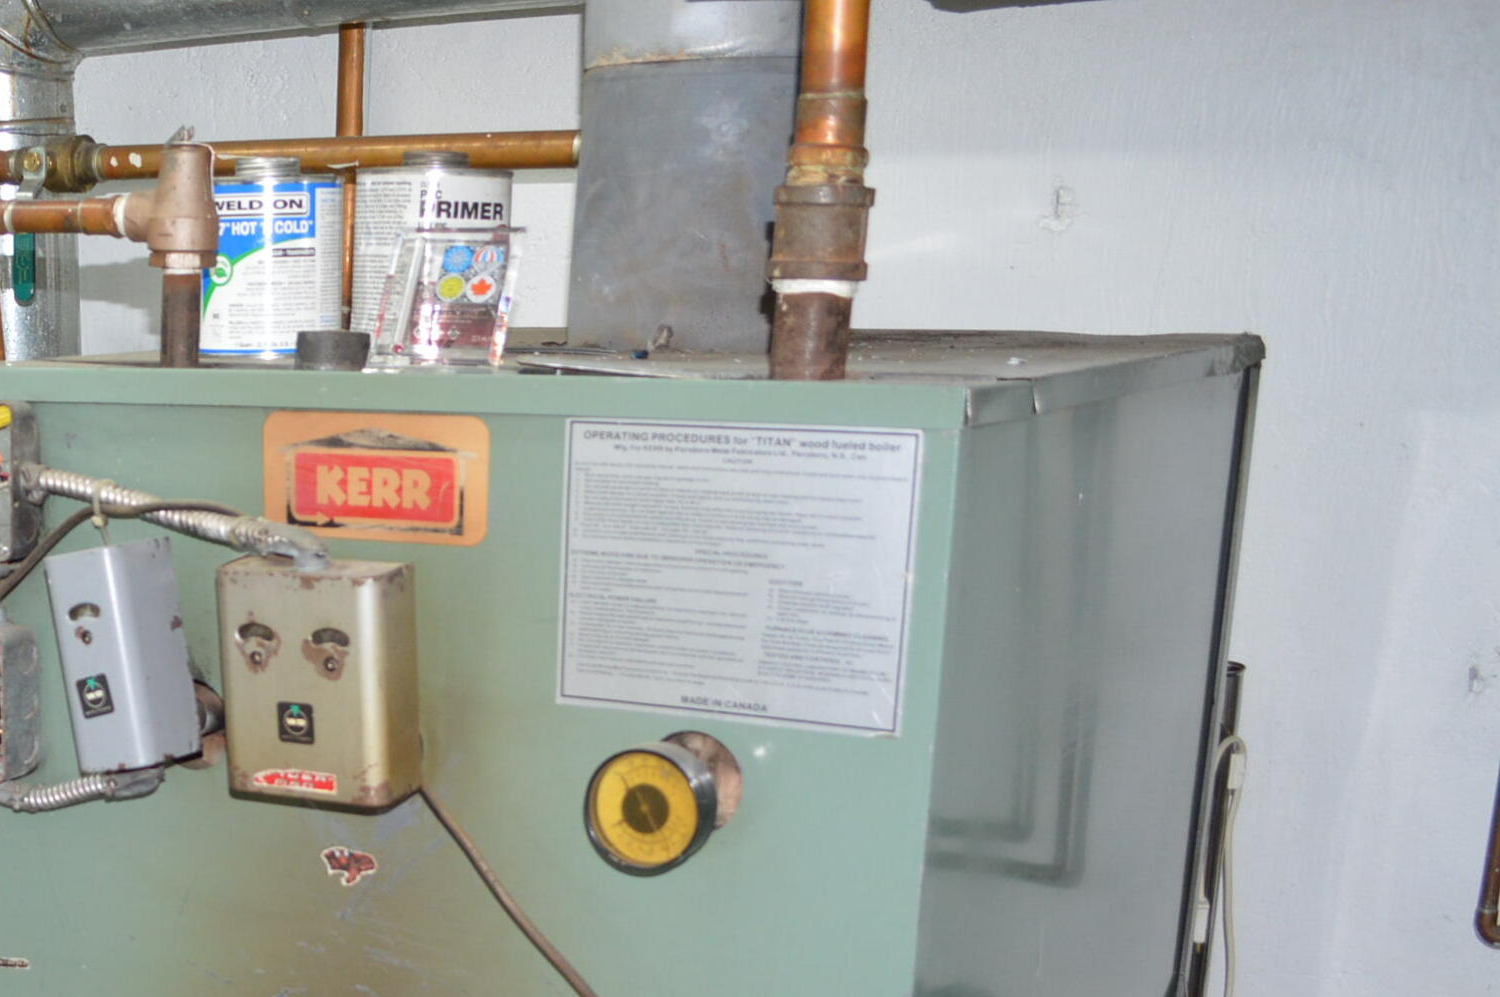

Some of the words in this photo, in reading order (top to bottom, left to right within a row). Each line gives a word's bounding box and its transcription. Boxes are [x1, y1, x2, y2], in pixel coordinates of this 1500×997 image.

[231, 221, 257, 236] HOT
[583, 430, 649, 442] OPERATING
[651, 433, 731, 445] PROCEDURES
[733, 436, 748, 446] for
[799, 439, 831, 450] wood
[832, 440, 867, 451] fueled
[868, 442, 902, 453] boiler
[316, 464, 432, 511] KERR
[681, 695, 708, 706] MADE
[712, 699, 722, 707] IN
[724, 700, 768, 712] CANADA
